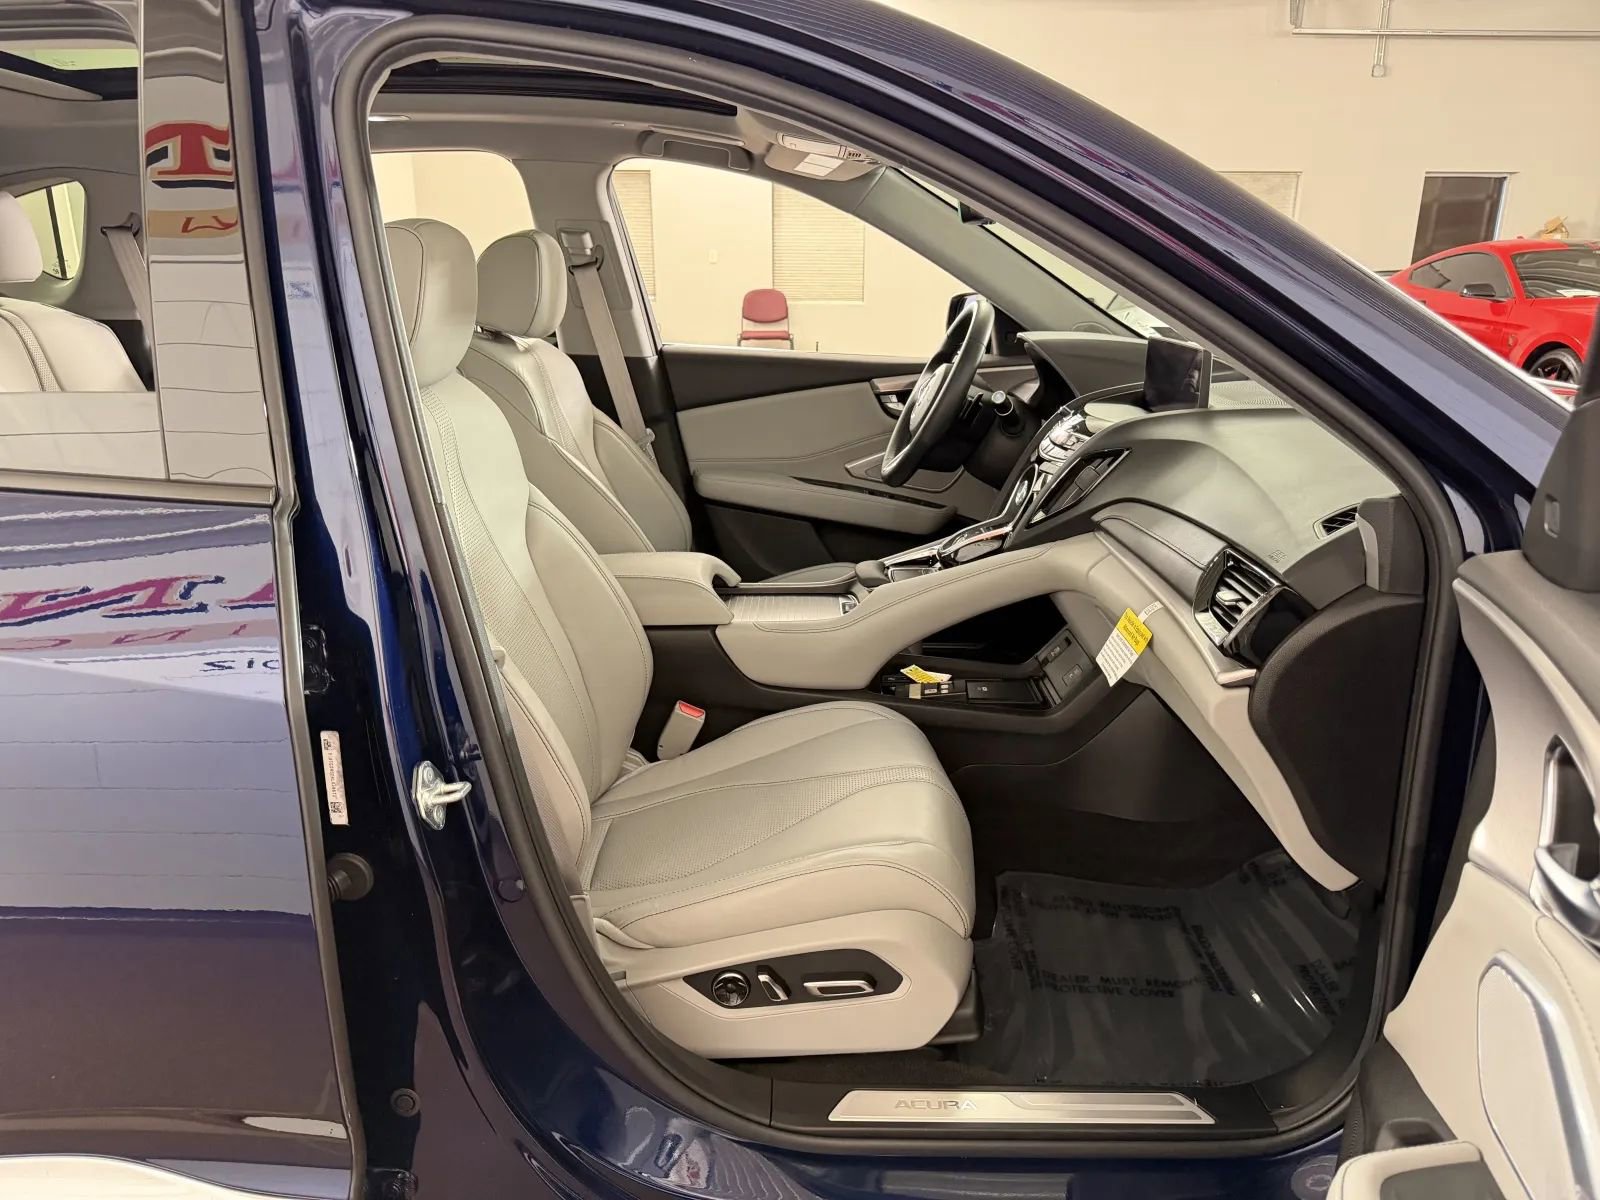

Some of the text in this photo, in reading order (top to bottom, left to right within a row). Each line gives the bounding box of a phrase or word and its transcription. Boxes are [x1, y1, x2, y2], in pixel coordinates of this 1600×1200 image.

[1100, 975, 1137, 986] MUST
[1129, 987, 1176, 998] COVER
[895, 1099, 977, 1110] ACURA
